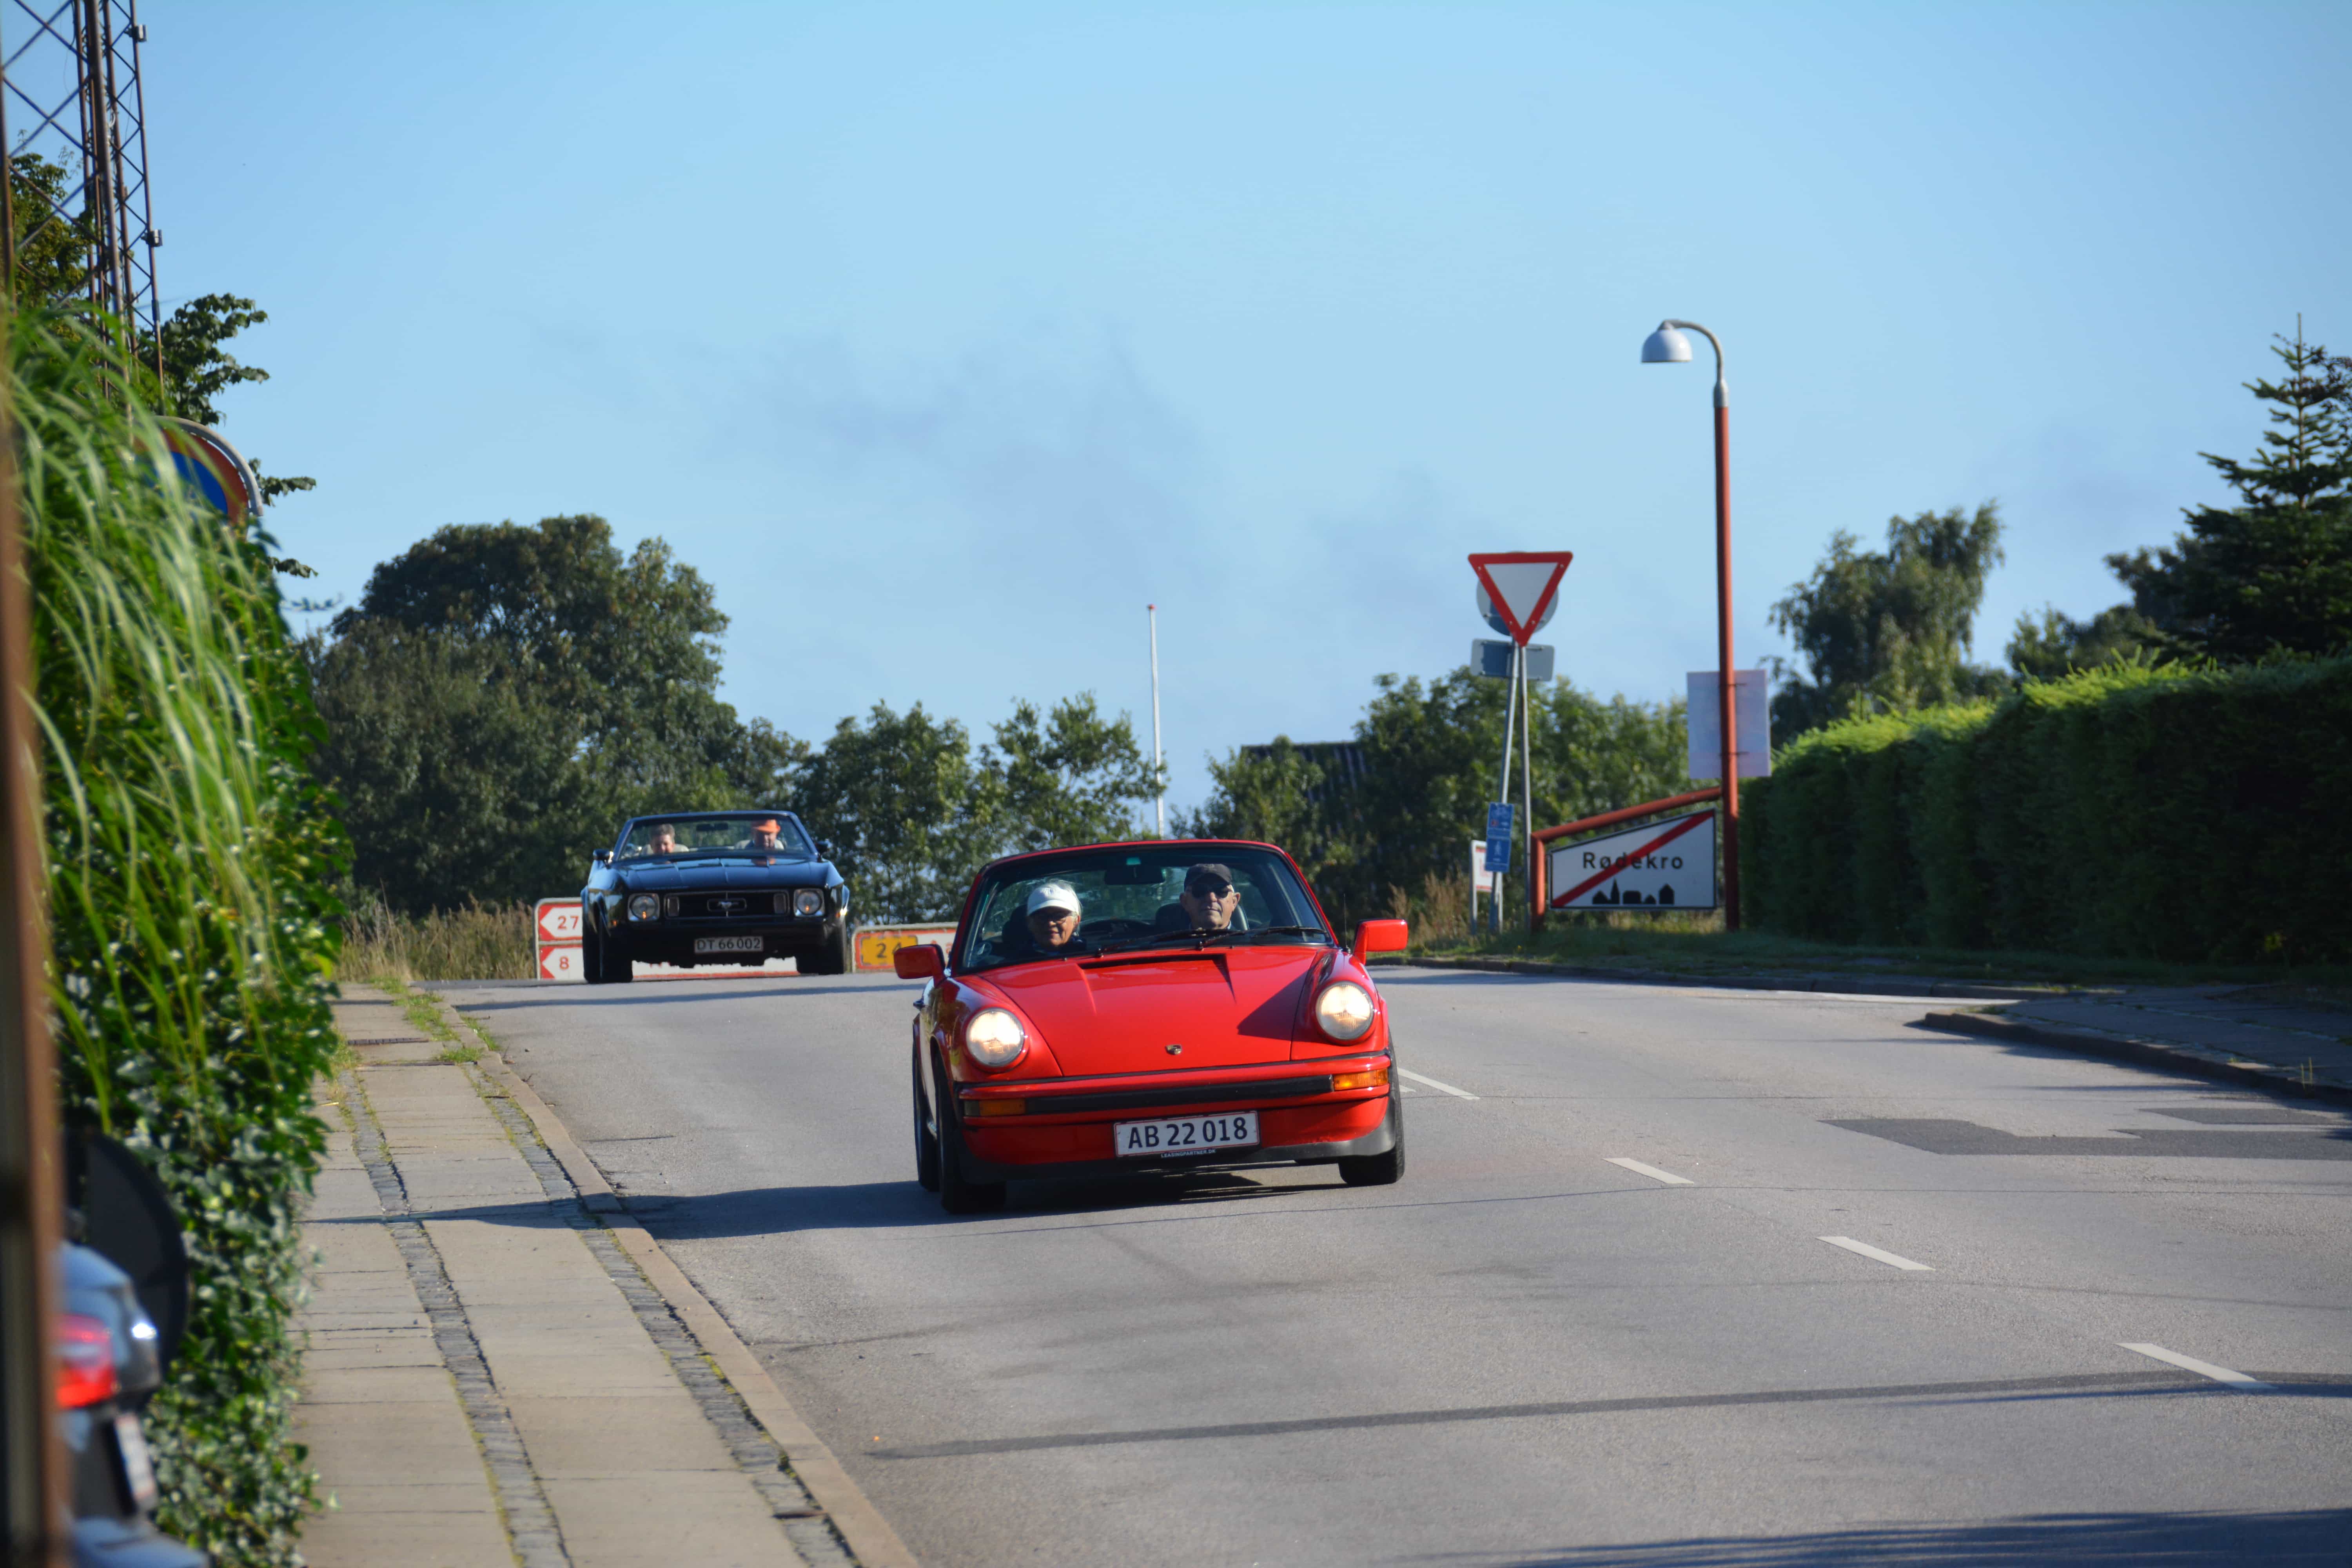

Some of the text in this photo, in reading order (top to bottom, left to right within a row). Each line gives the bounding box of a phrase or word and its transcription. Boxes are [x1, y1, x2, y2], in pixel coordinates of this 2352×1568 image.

[1583, 851, 1683, 869] Rødekro
[558, 915, 579, 930] 27
[697, 937, 760, 950] DT 66 002
[559, 956, 569, 970] 8
[1128, 1117, 1248, 1149] AB 22 018
[1161, 1149, 1216, 1158] LEASINGPARTNER.DK
